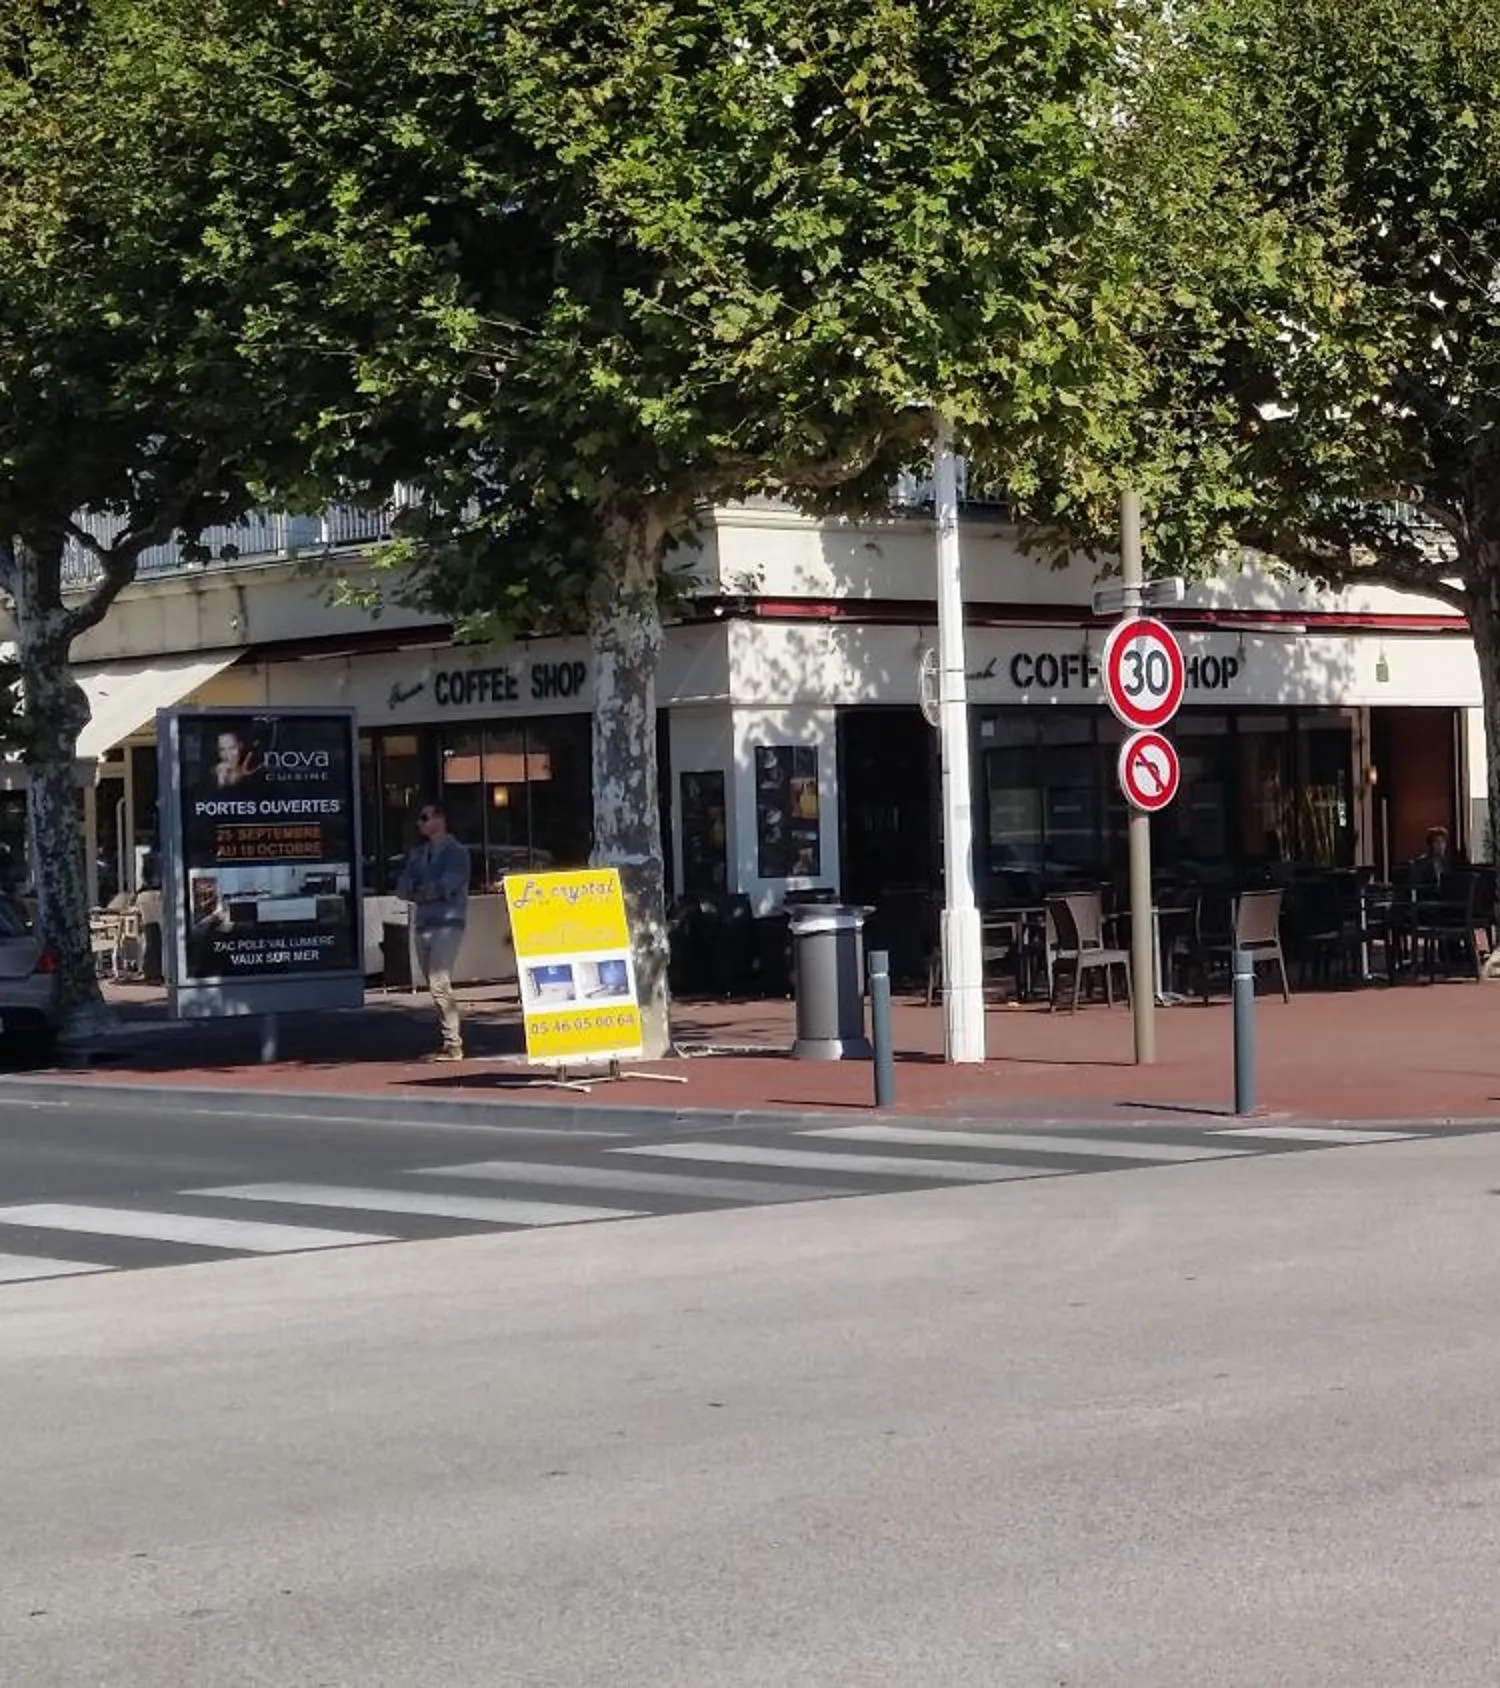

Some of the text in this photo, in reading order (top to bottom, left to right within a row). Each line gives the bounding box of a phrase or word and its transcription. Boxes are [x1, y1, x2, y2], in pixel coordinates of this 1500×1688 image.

[1010, 653, 1104, 689] COFF
[1182, 655, 1239, 689] HOP
[1123, 649, 1170, 697] 30
[434, 667, 519, 706] COFFEE
[531, 661, 587, 700] SHOP
[195, 799, 340, 816] PORTES OUVERTES
[238, 826, 321, 841] SEPTEMBRE
[217, 844, 237, 857] AU
[257, 841, 321, 856] OCTOBRE
[230, 949, 321, 965] VAUX SUR MER
